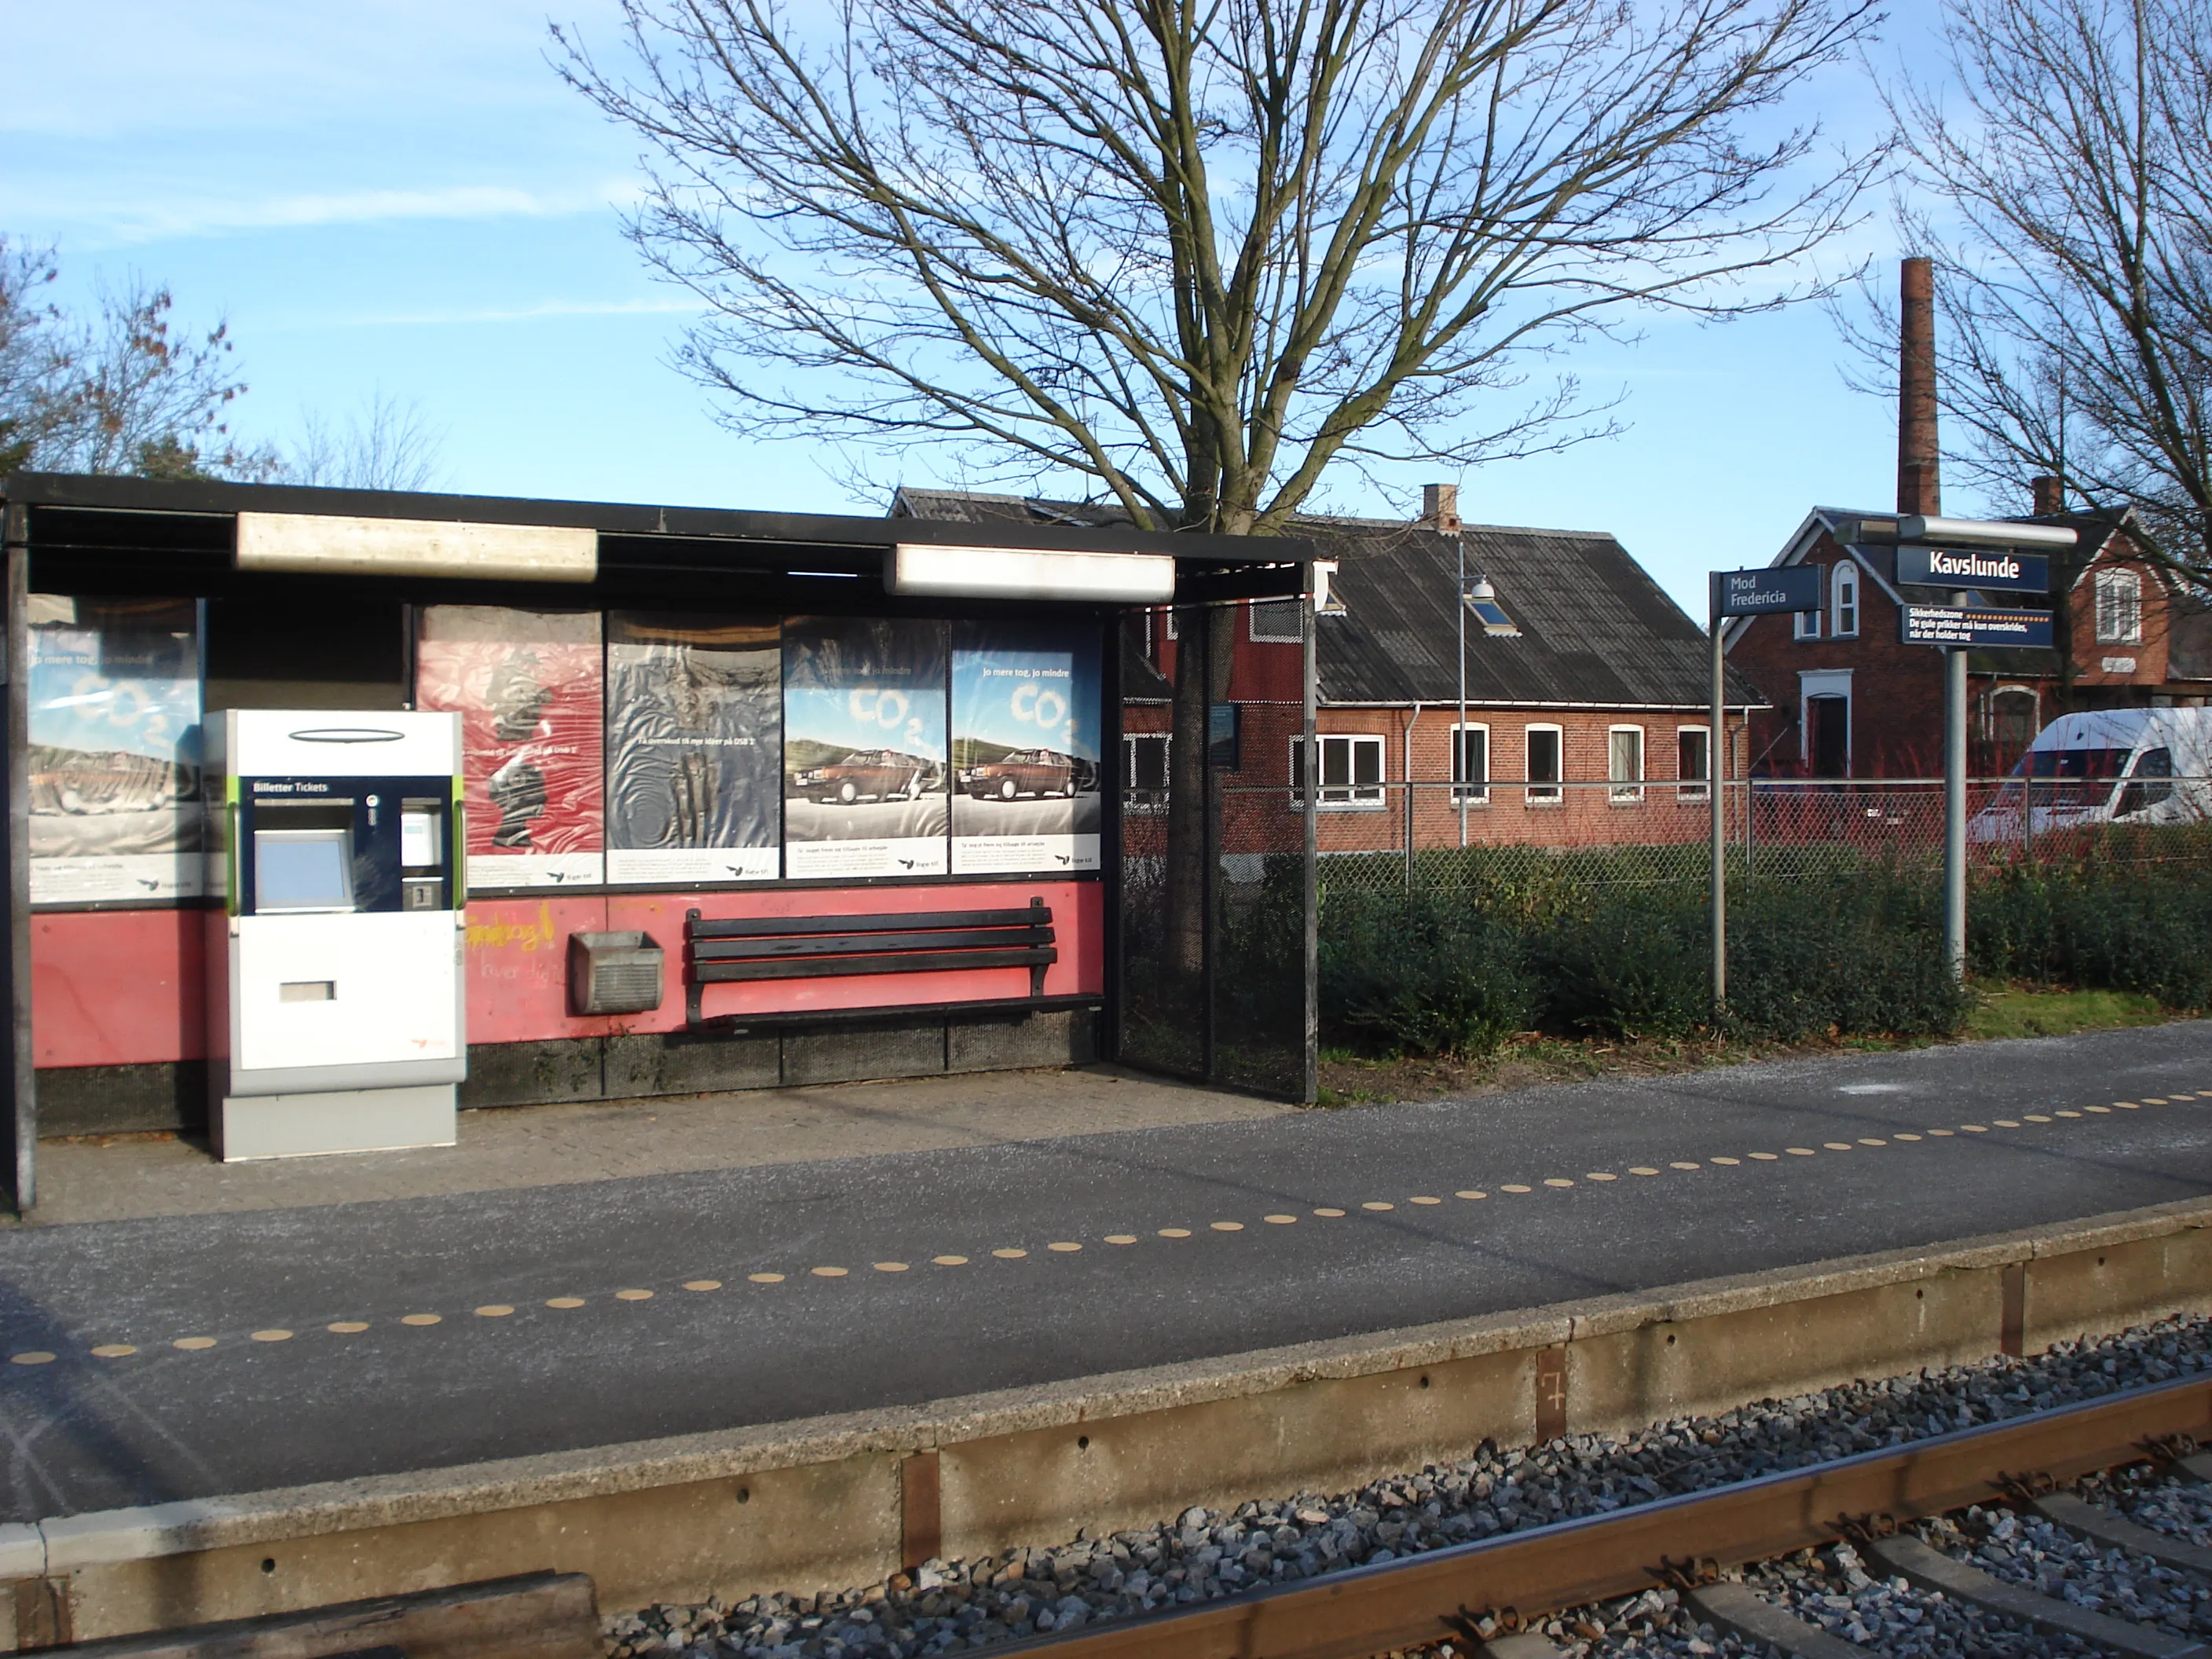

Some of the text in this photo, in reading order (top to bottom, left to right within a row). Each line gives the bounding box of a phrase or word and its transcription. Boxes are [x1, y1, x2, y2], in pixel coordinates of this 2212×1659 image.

[1930, 551, 2020, 579] Kavslunde
[1731, 576, 1756, 590] Mod
[1731, 591, 1786, 606] Fredericia
[1909, 607, 1963, 619] Sikkerhedszone
[1909, 618, 2027, 633] De gule prikker må kun overskrides,
[1909, 628, 1971, 642] når der holder tog
[45, 656, 73, 665] mere
[1015, 668, 1031, 678] tog,
[1042, 668, 1069, 678] mindre
[723, 737, 733, 746] på
[253, 782, 328, 793] Billetter Tickets
